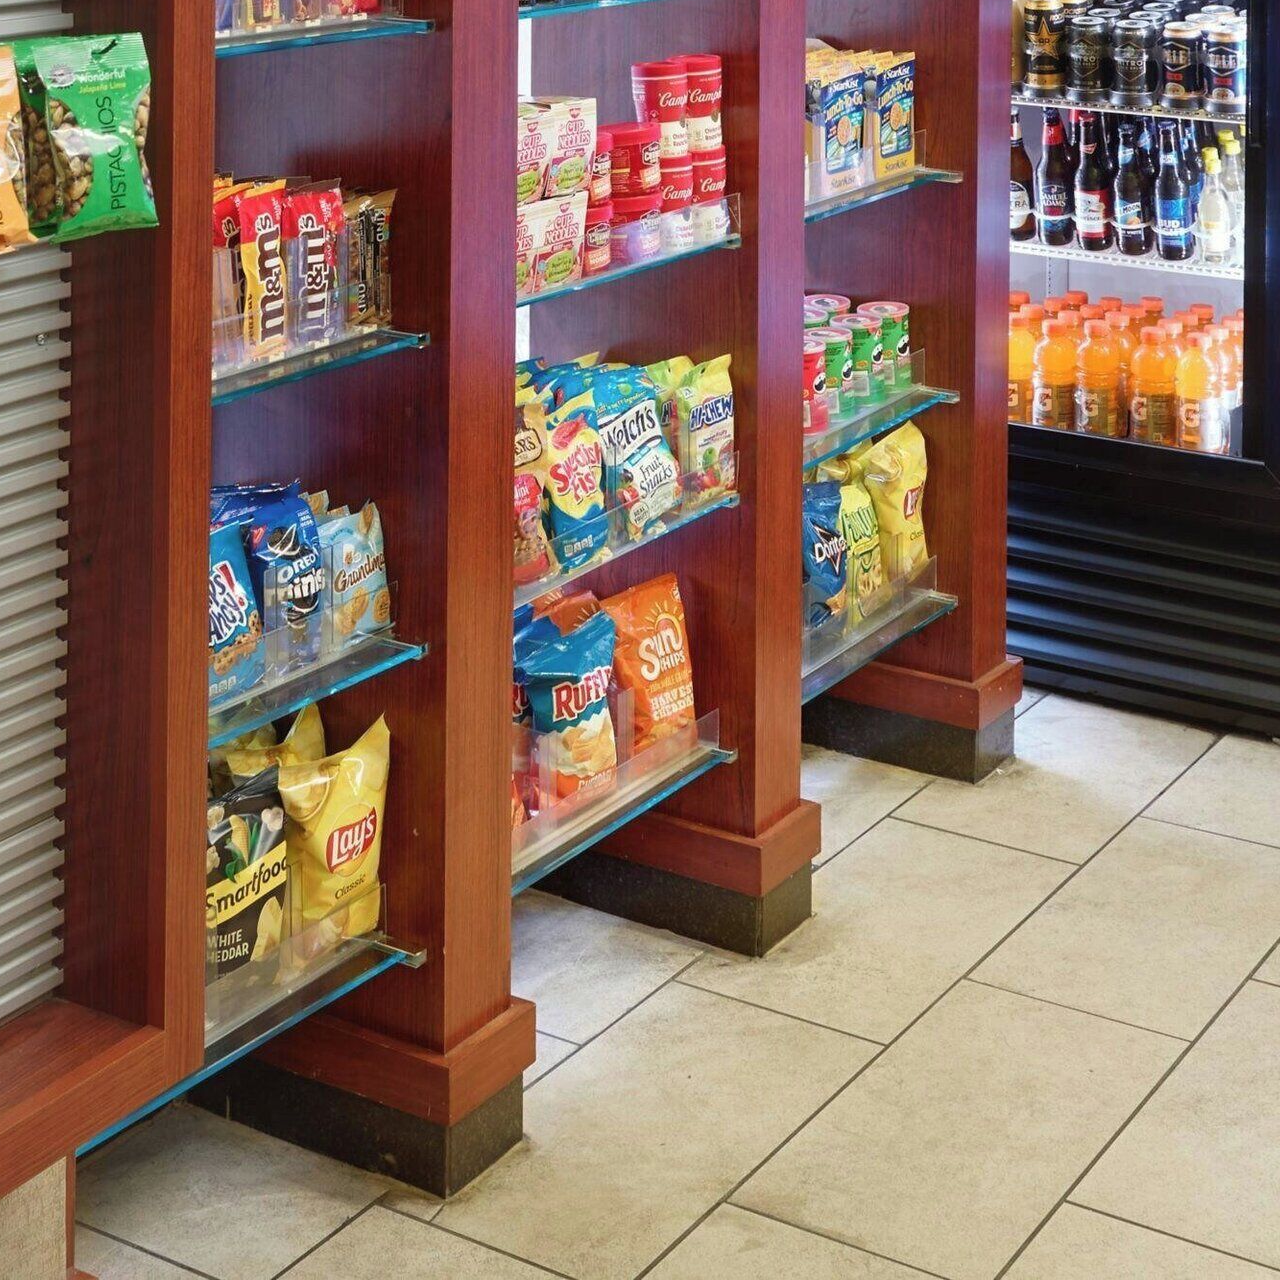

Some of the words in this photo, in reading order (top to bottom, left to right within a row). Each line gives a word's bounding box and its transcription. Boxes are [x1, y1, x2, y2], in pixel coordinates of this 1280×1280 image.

[78, 69, 126, 83] Wonderful
[882, 66, 911, 82] StarKist
[566, 119, 585, 134] CUP
[1043, 199, 1066, 207] ADAMS
[373, 208, 387, 243] KIND
[554, 212, 575, 232] CUP
[257, 212, 286, 345] m&m's
[298, 212, 331, 334] m&m's
[357, 283, 368, 316] KIND
[598, 405, 657, 450] Welch's
[549, 440, 604, 496] Swedish
[638, 463, 675, 500] Snacks
[639, 456, 665, 479] Fruit
[814, 534, 847, 564] Dorito
[277, 553, 317, 583] OREO
[638, 611, 685, 683] SUN
[660, 652, 686, 673] CHIPS
[328, 810, 378, 866] Lay's
[334, 873, 367, 902] Classic
